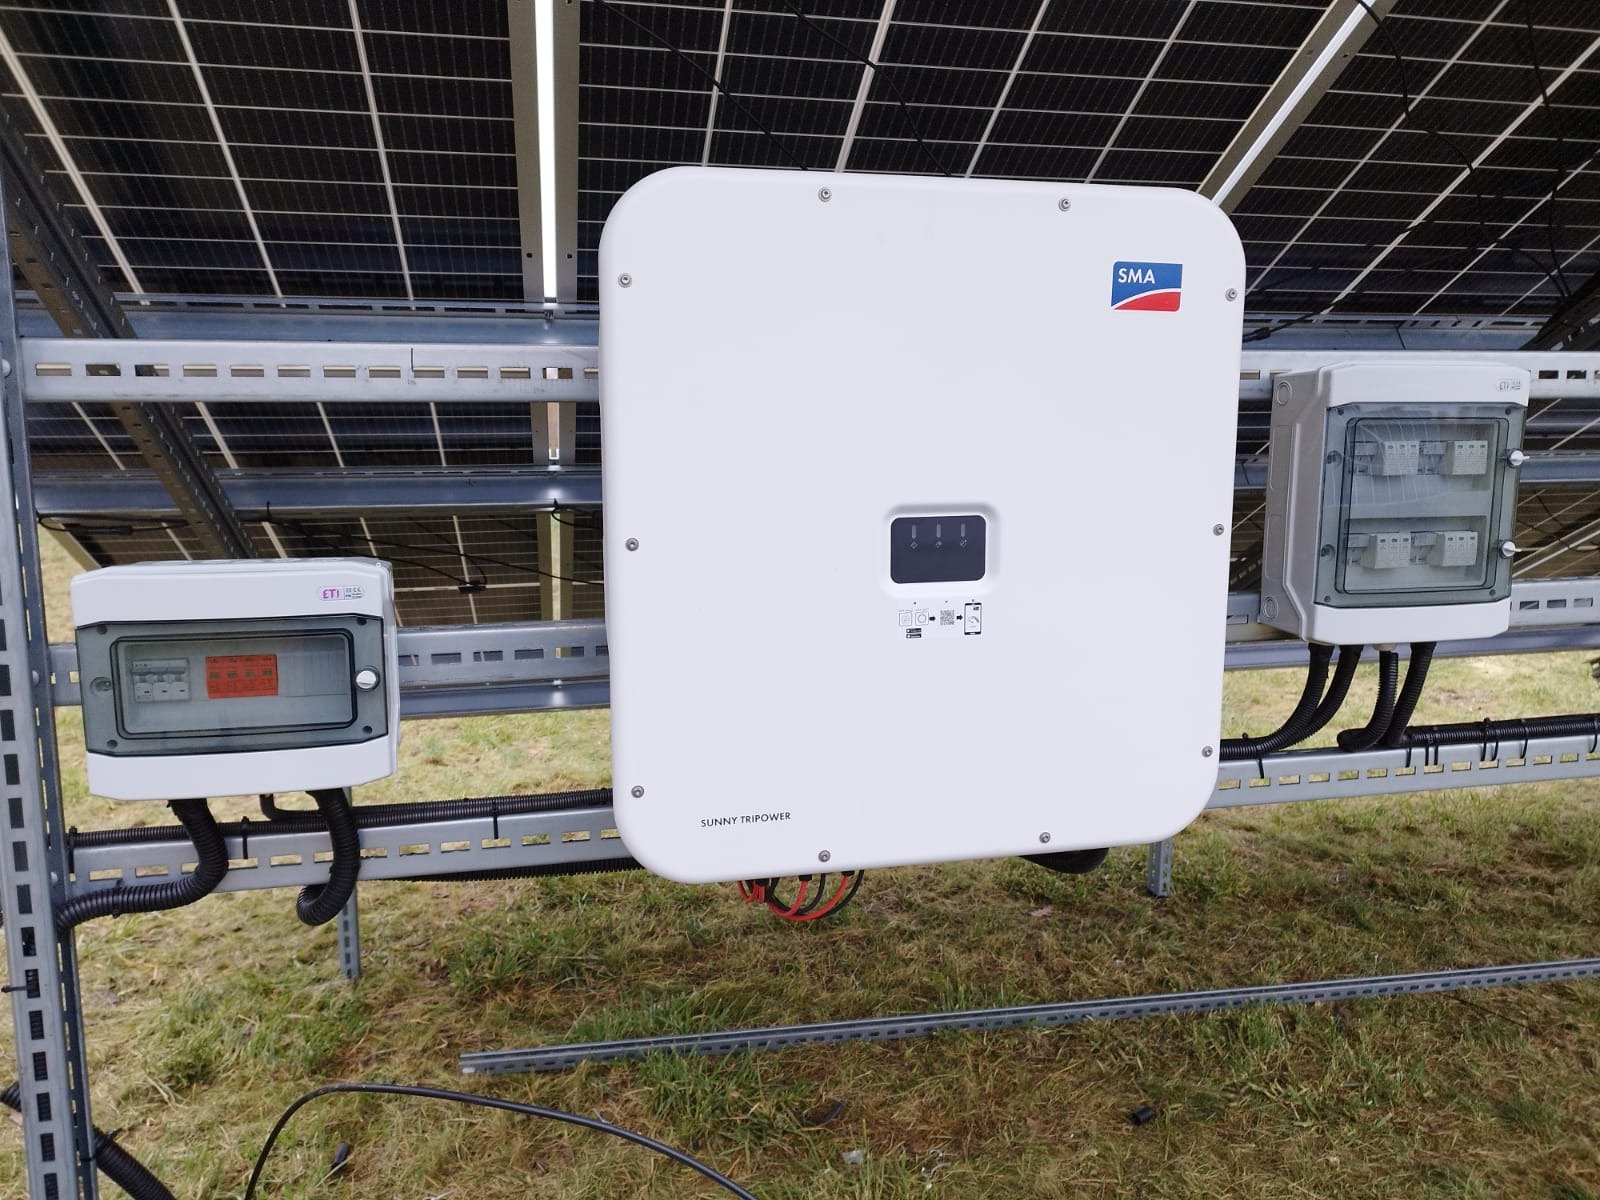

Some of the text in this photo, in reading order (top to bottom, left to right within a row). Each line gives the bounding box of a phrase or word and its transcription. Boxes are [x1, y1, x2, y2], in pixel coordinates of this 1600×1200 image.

[1118, 268, 1156, 284] SMA
[322, 588, 340, 599] ETI
[700, 811, 791, 828] SUNNY TRIPOWER
